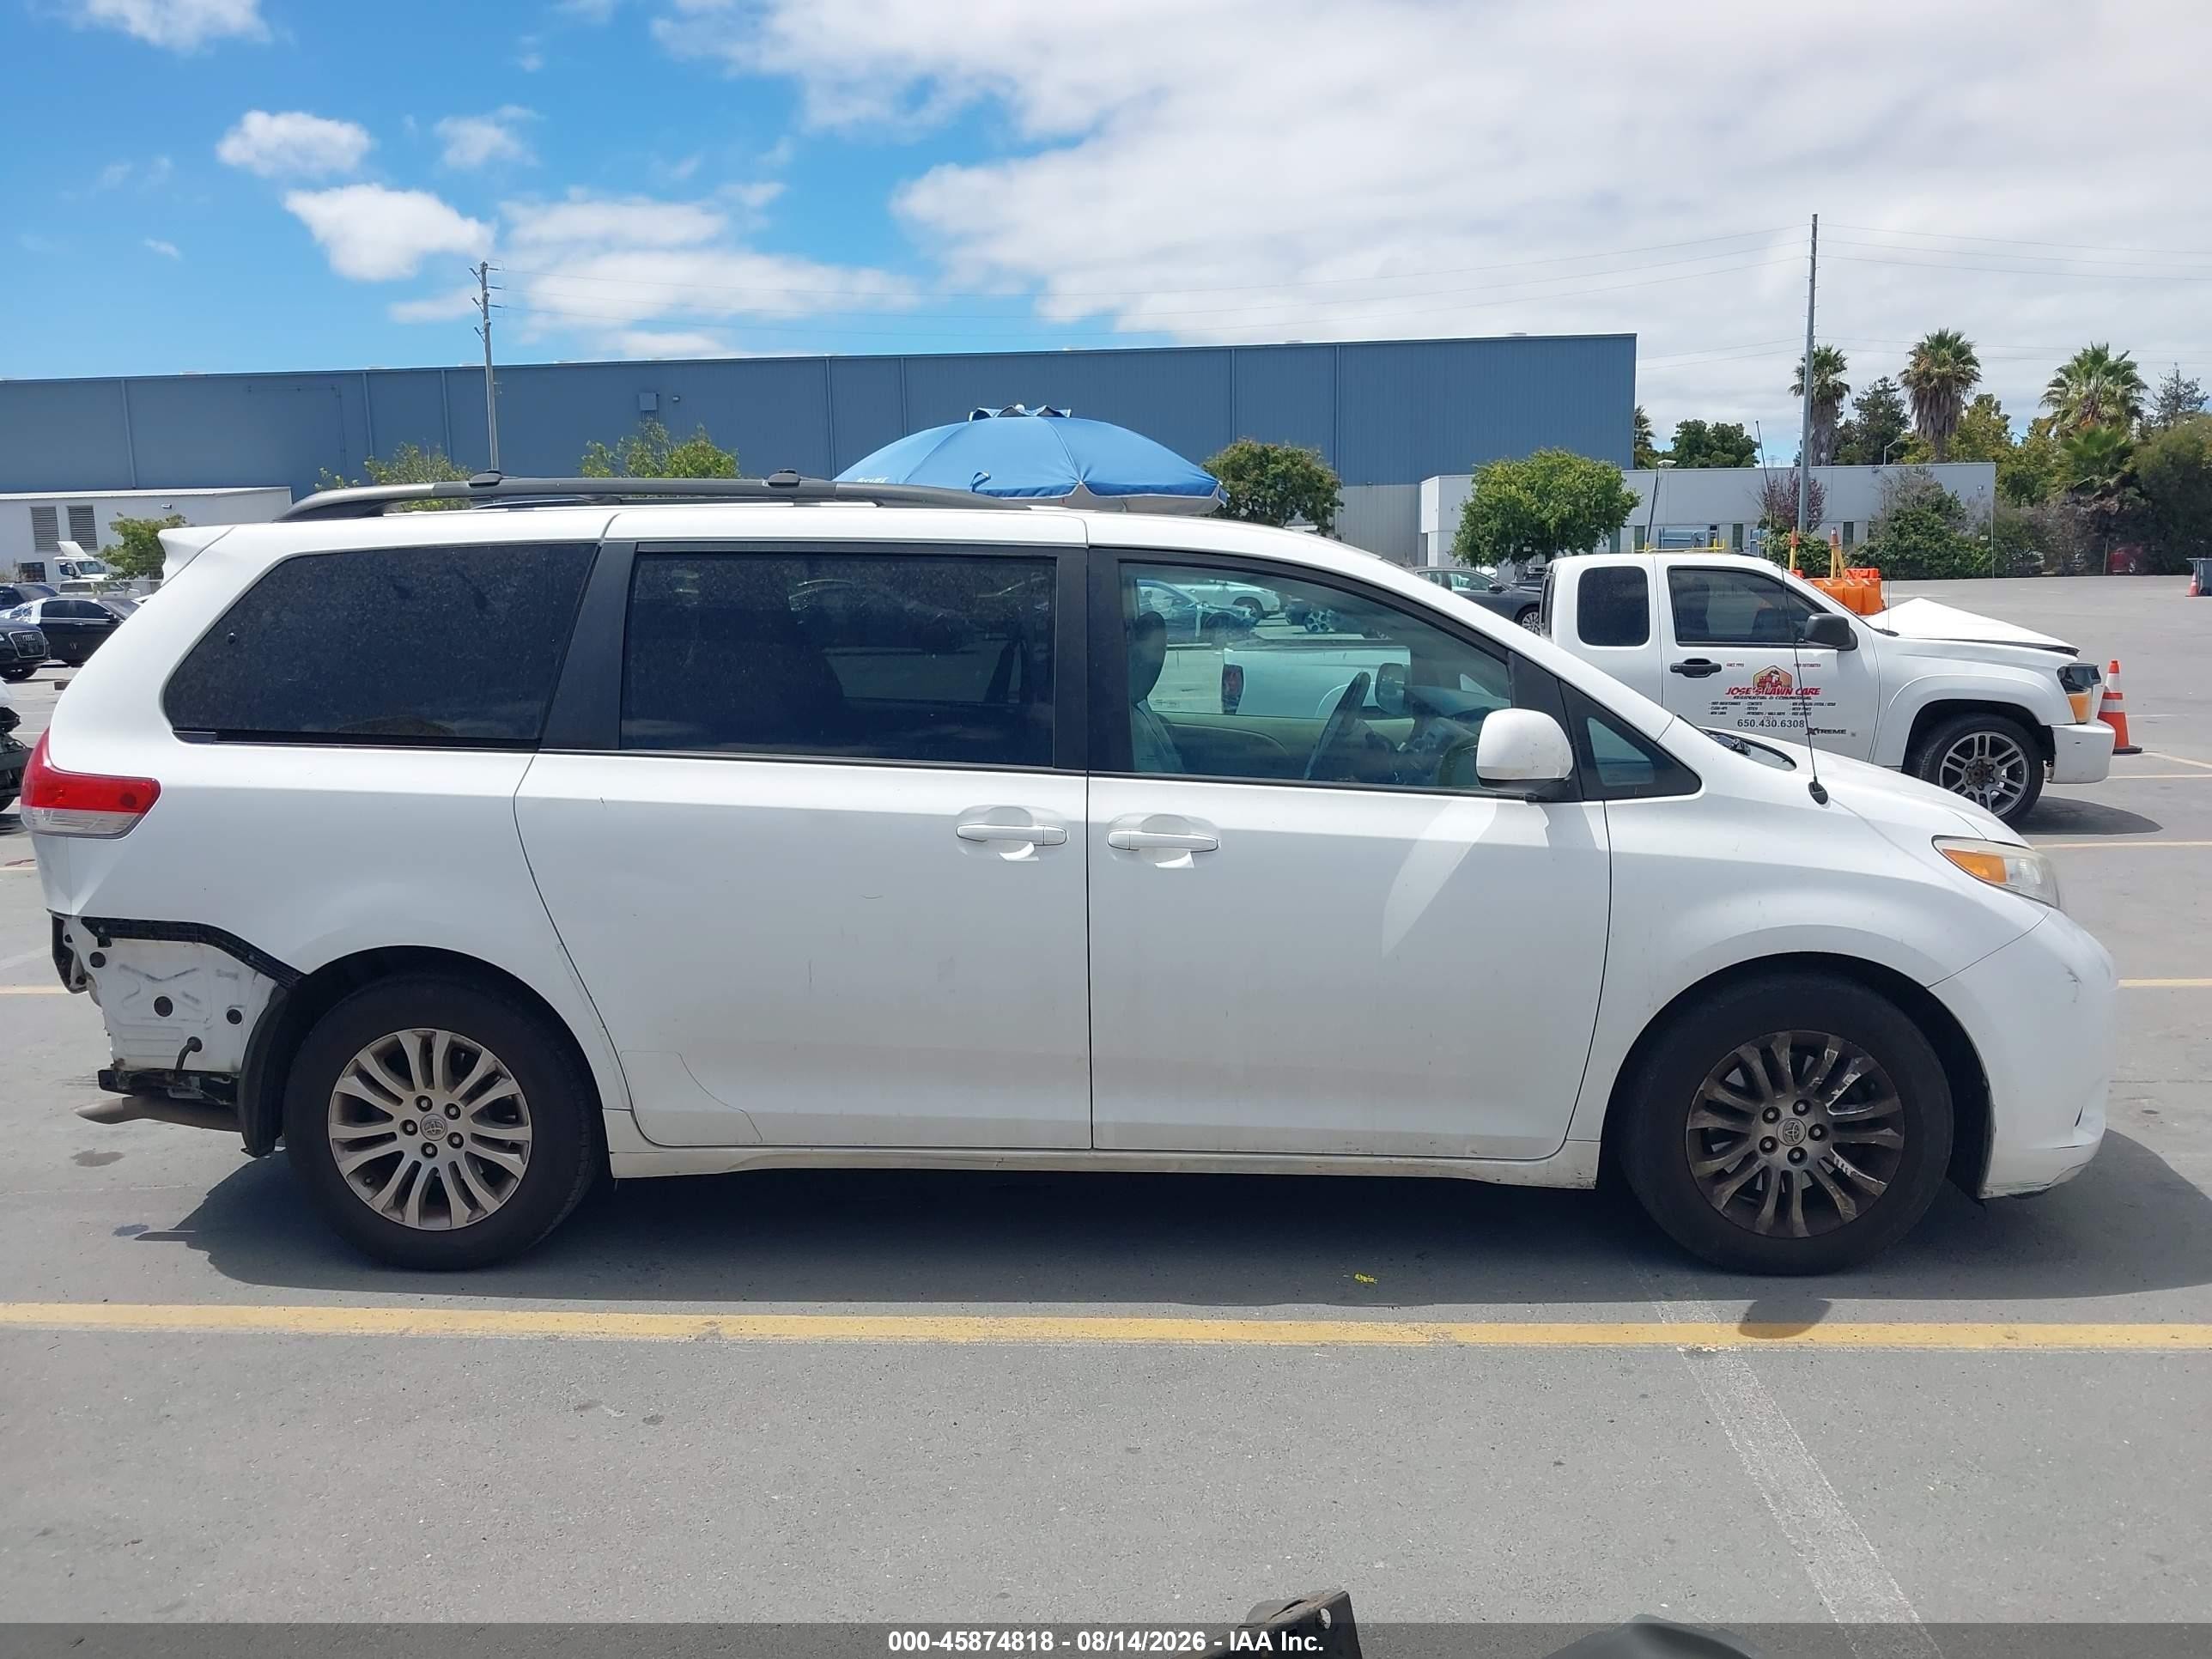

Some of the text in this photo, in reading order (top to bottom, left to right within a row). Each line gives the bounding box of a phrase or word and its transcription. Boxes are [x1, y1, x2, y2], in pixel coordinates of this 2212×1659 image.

[1765, 687, 1793, 696] LAWN
[1796, 687, 1820, 696] CARE
[1737, 719, 1805, 728] 650.430.6308
[1805, 727, 1846, 736] XTREME
